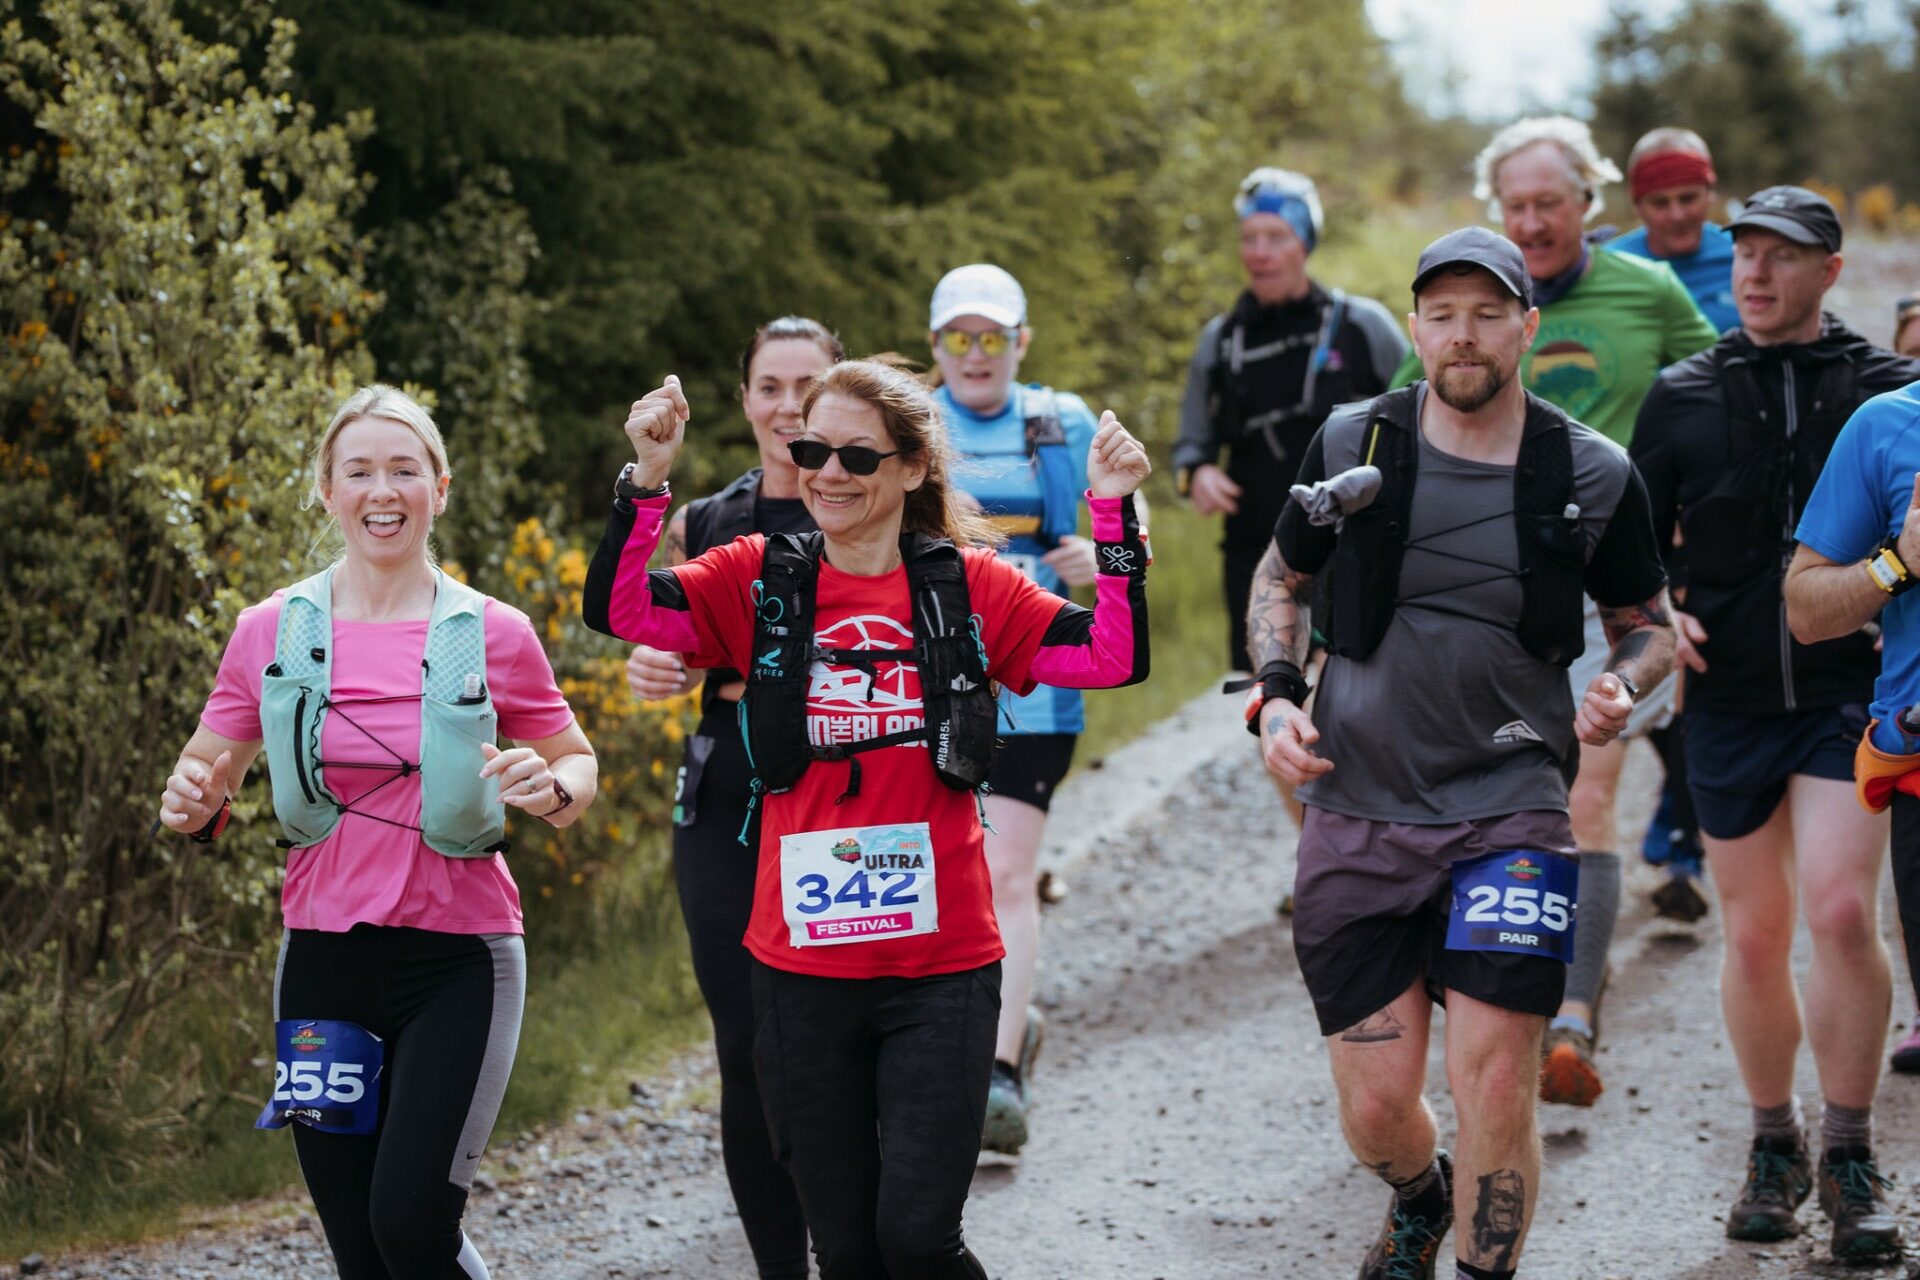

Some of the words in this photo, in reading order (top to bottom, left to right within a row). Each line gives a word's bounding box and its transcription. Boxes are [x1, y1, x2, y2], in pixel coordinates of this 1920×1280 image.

[831, 715, 852, 745] THE
[865, 854, 925, 870] ULTRA
[795, 870, 919, 915] 342
[1464, 885, 1569, 931] 255
[816, 917, 902, 936] FESTIVAL
[1499, 932, 1539, 946] PAIR
[274, 1061, 364, 1103] 255
